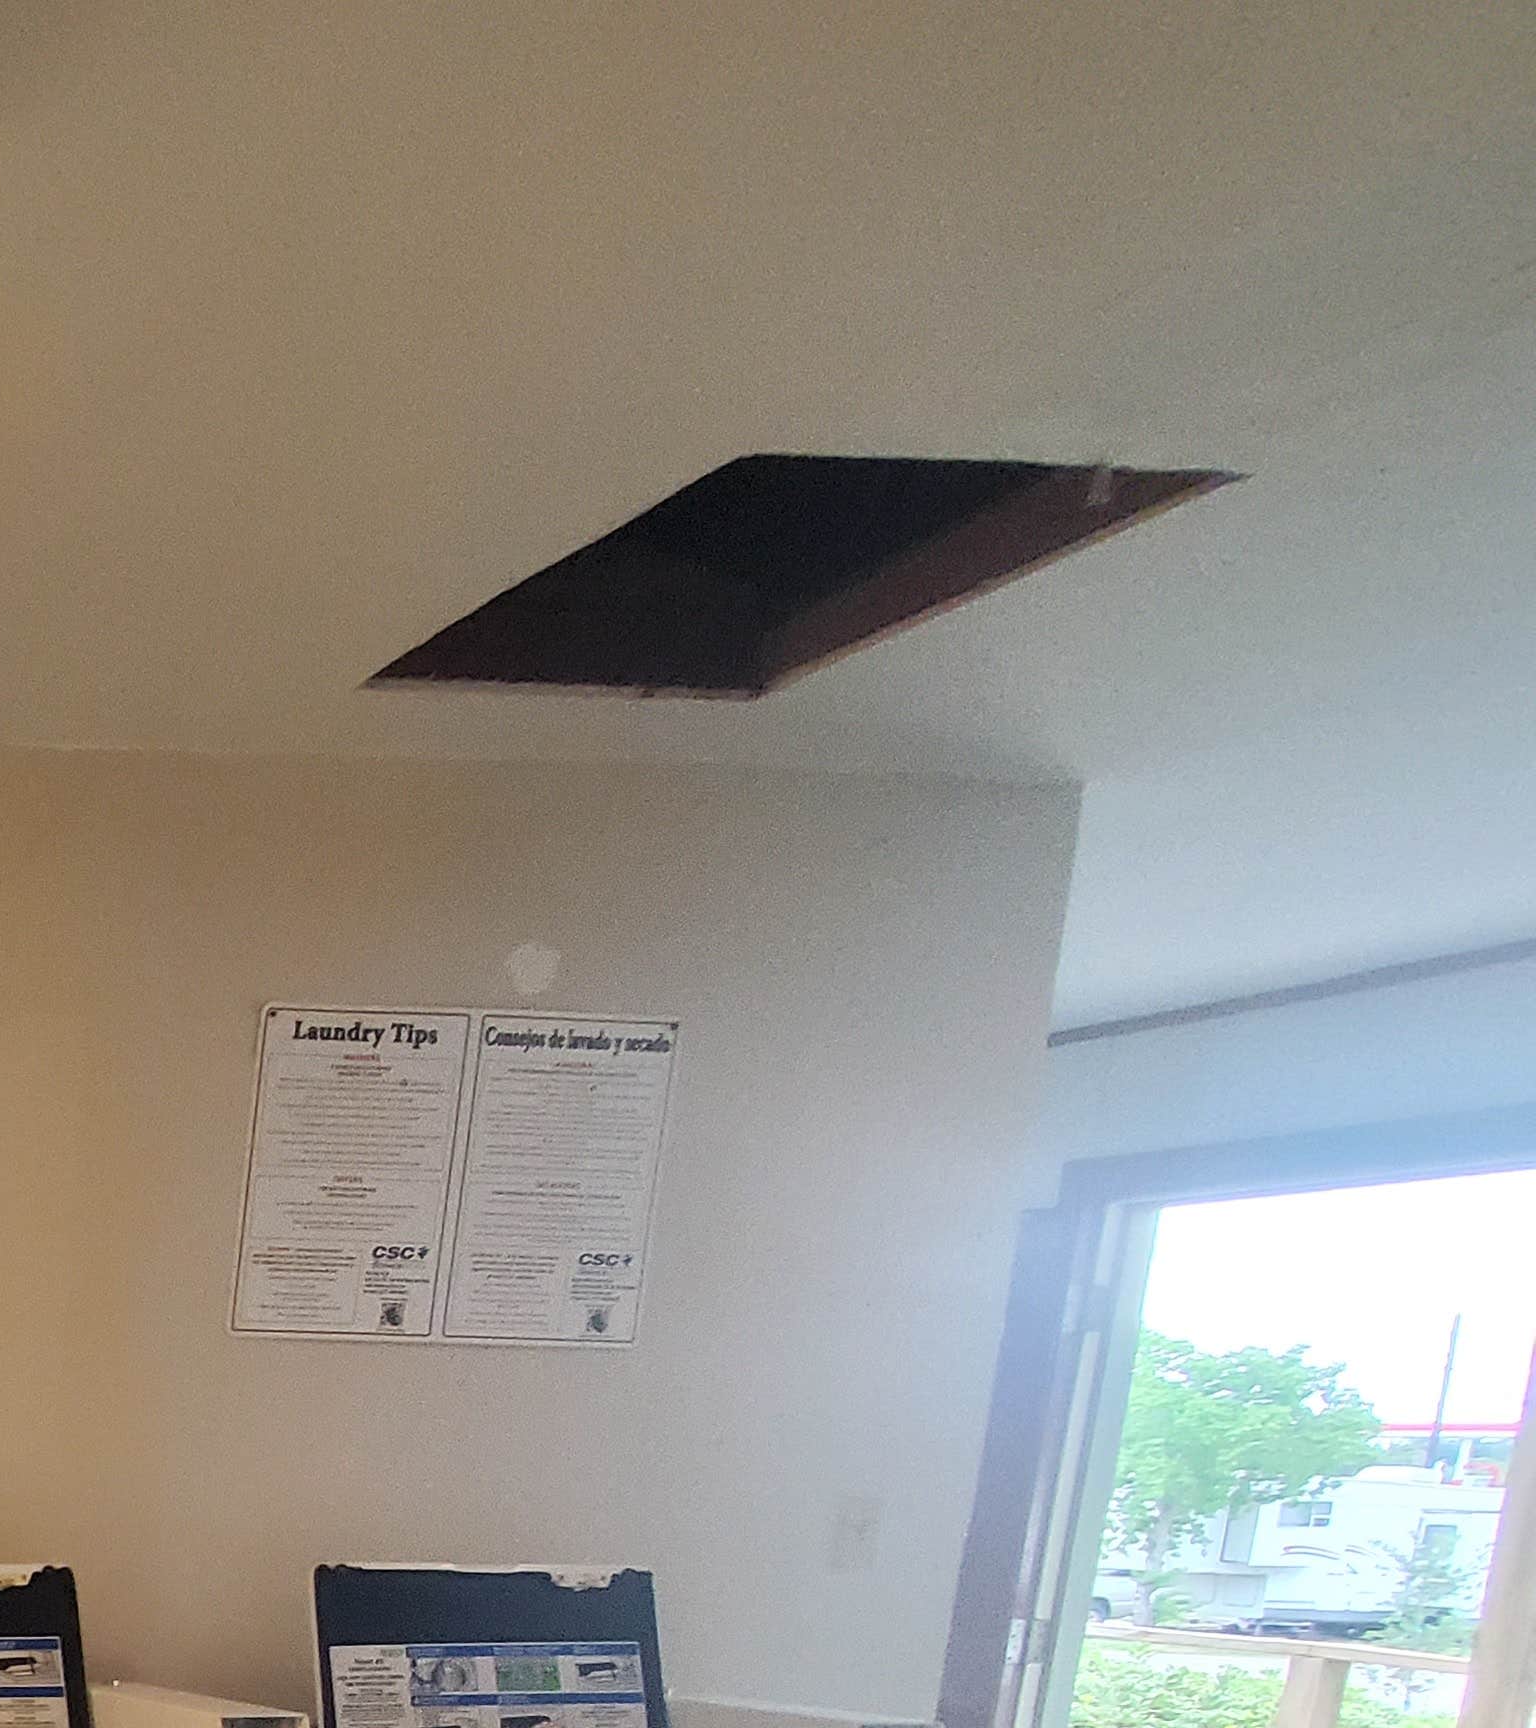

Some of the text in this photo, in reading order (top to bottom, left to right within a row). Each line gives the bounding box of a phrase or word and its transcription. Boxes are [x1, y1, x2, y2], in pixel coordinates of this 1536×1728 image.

[293, 1021, 438, 1049] Laundry Tips
[485, 1026, 546, 1053] Consejos
[548, 1029, 565, 1049] de
[613, 1038, 623, 1056] y
[372, 1246, 415, 1260] CSC
[579, 1253, 620, 1266] CSC
